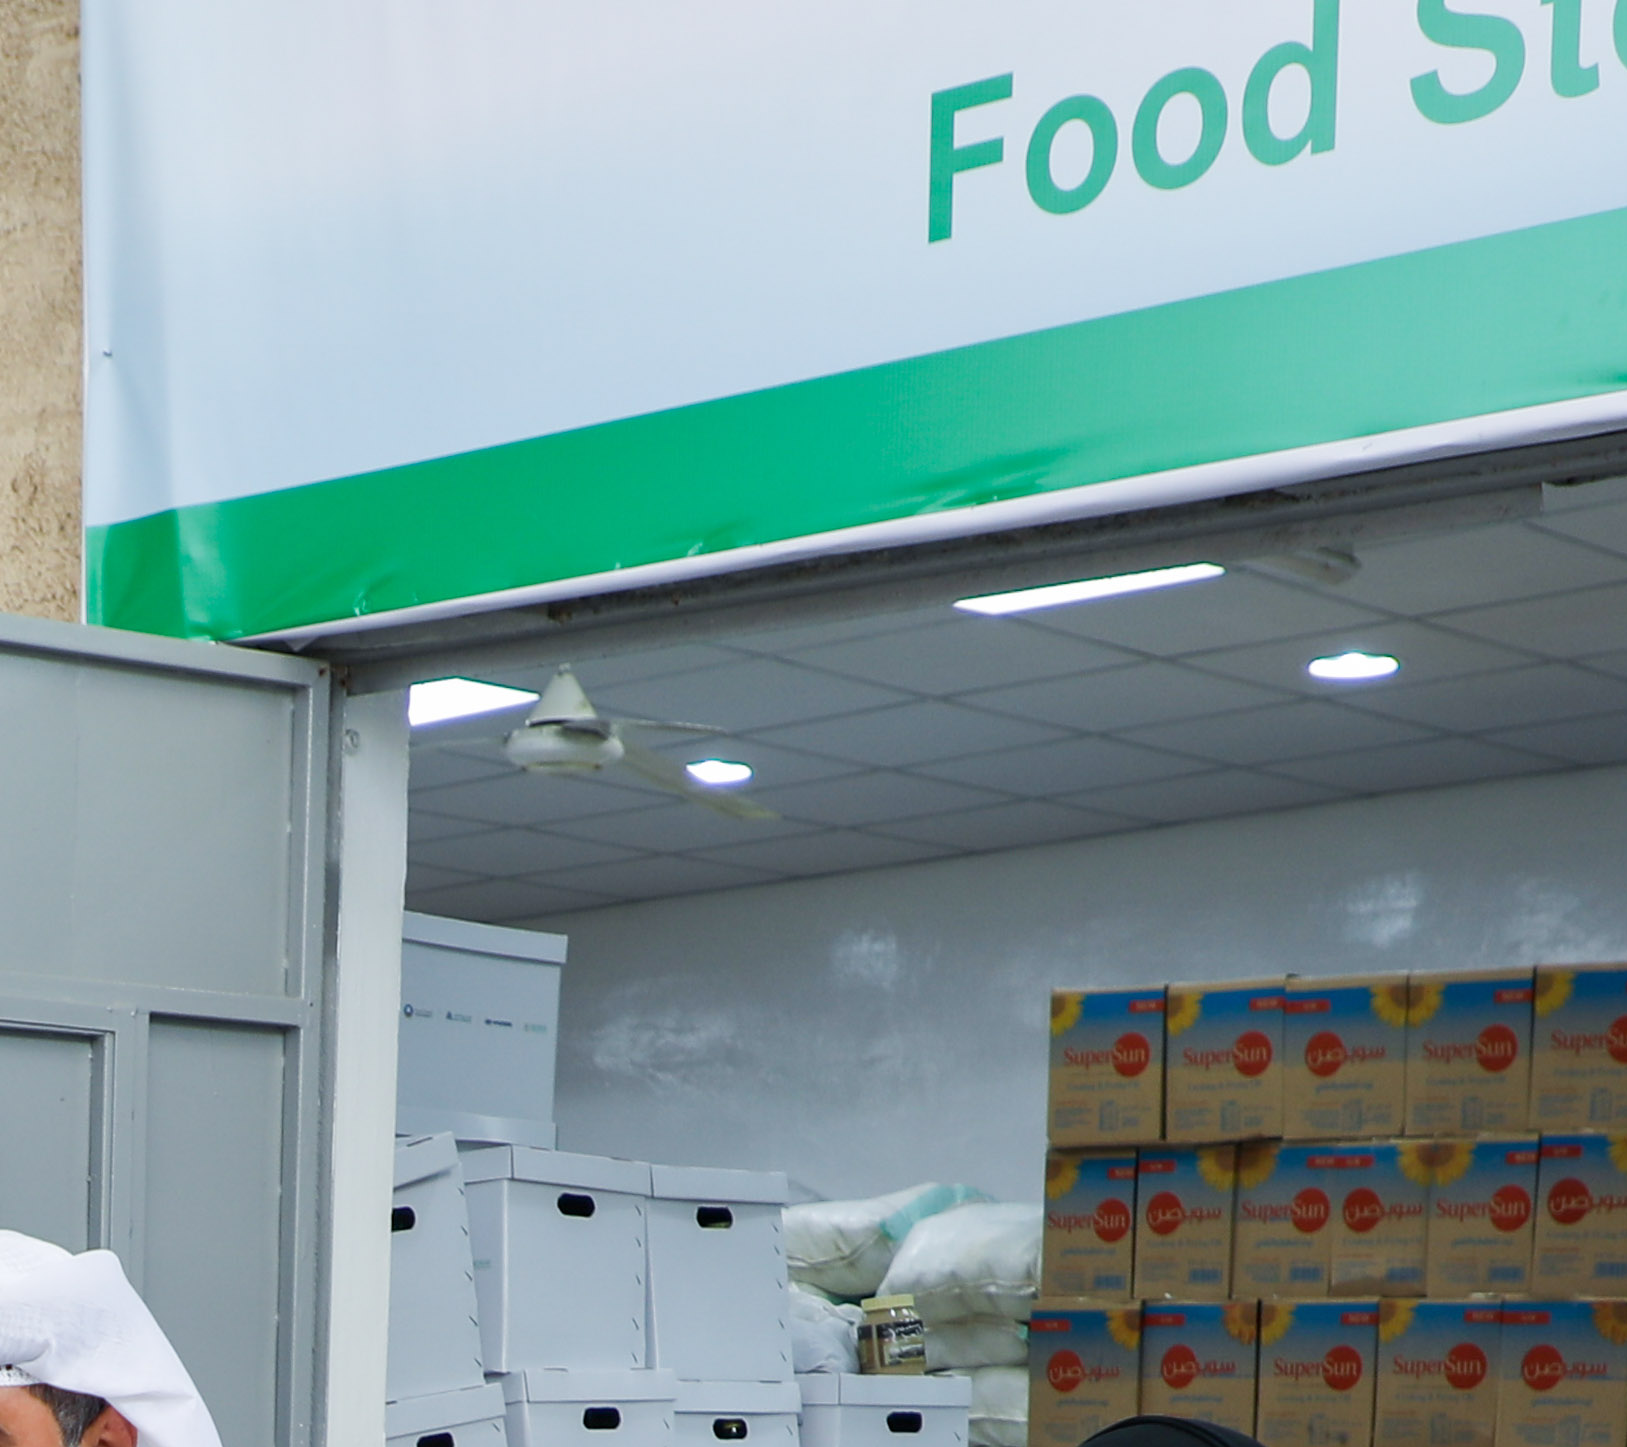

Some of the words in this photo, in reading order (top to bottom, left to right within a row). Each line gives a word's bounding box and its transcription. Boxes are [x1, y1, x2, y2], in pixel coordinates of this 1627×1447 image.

[928, 0, 1340, 243] Food
[1063, 1043, 1147, 1068] SuperSun
[1183, 1042, 1269, 1069] SuperSun
[1423, 1035, 1514, 1064] SuperSun
[1048, 1208, 1127, 1232] SuperSun
[1242, 1197, 1325, 1225] SuperSun
[1435, 1196, 1527, 1223] SuperSun
[1274, 1355, 1358, 1382] SuperSun
[1393, 1353, 1482, 1379] SuperSun
